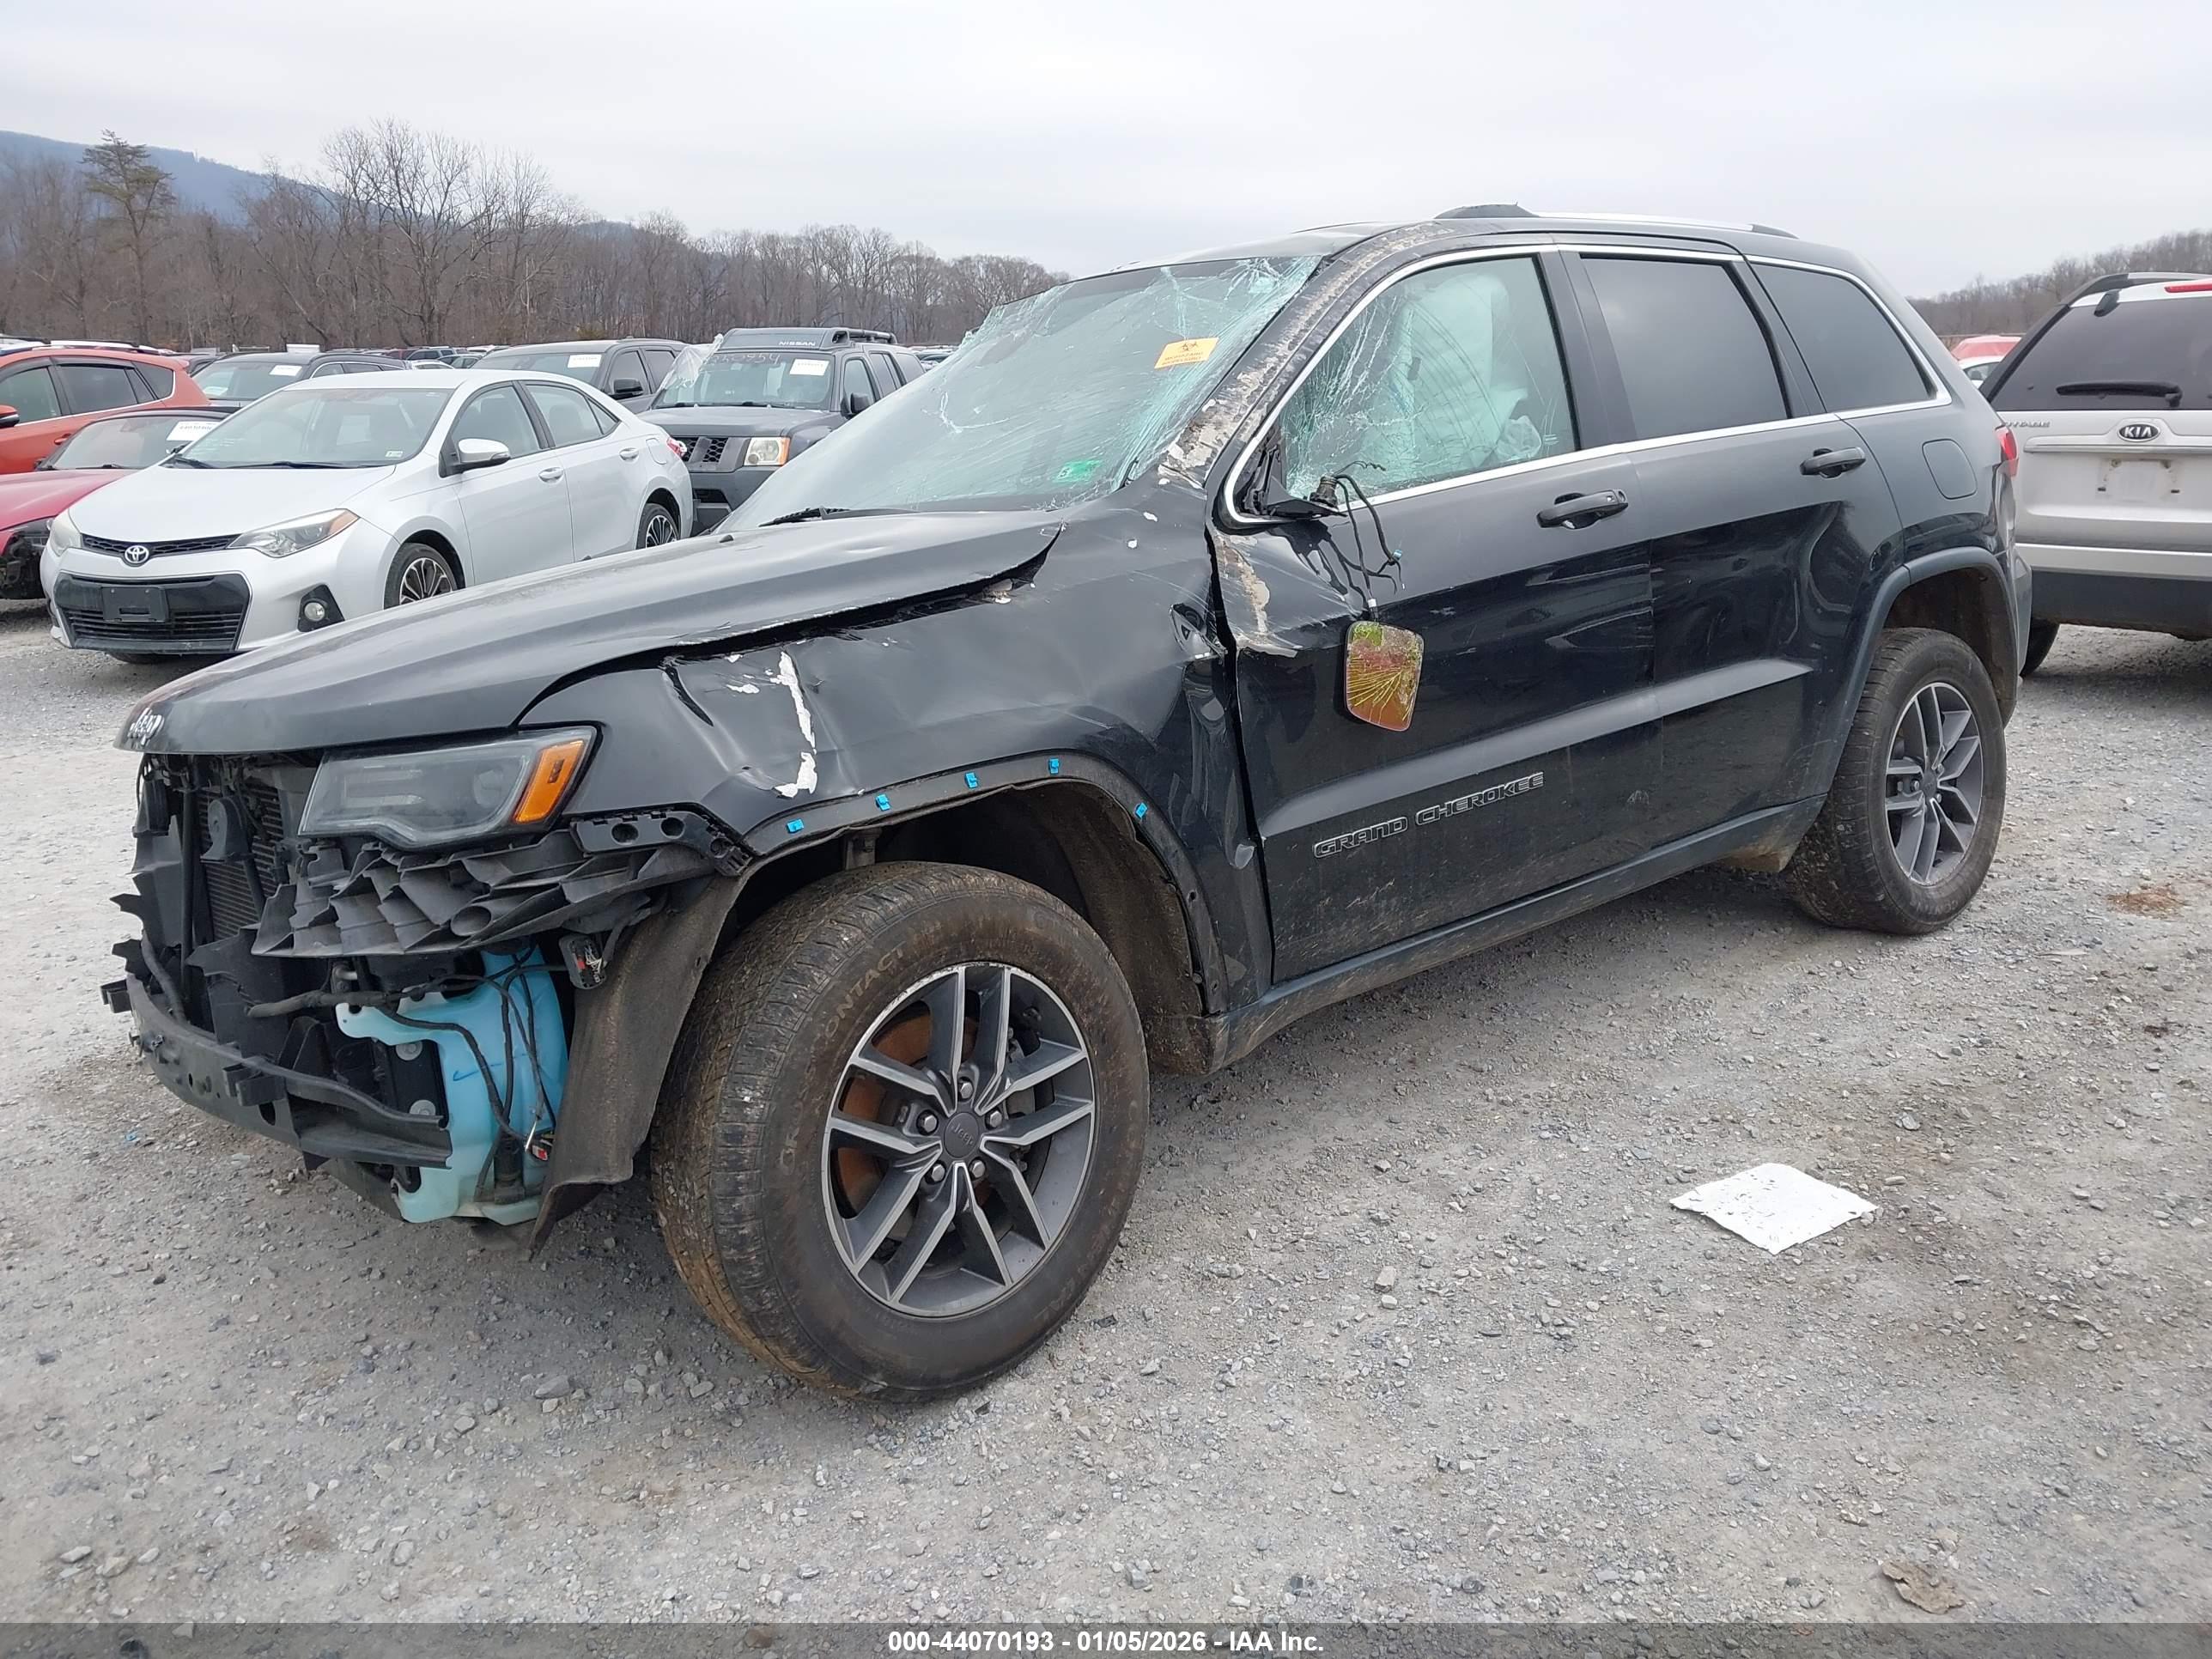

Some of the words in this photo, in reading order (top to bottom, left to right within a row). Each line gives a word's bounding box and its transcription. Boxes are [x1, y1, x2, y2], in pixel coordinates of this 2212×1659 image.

[2124, 427, 2152, 438] KIA
[1313, 817, 1408, 858] GRAND
[1416, 772, 1544, 825] CHEROKEE
